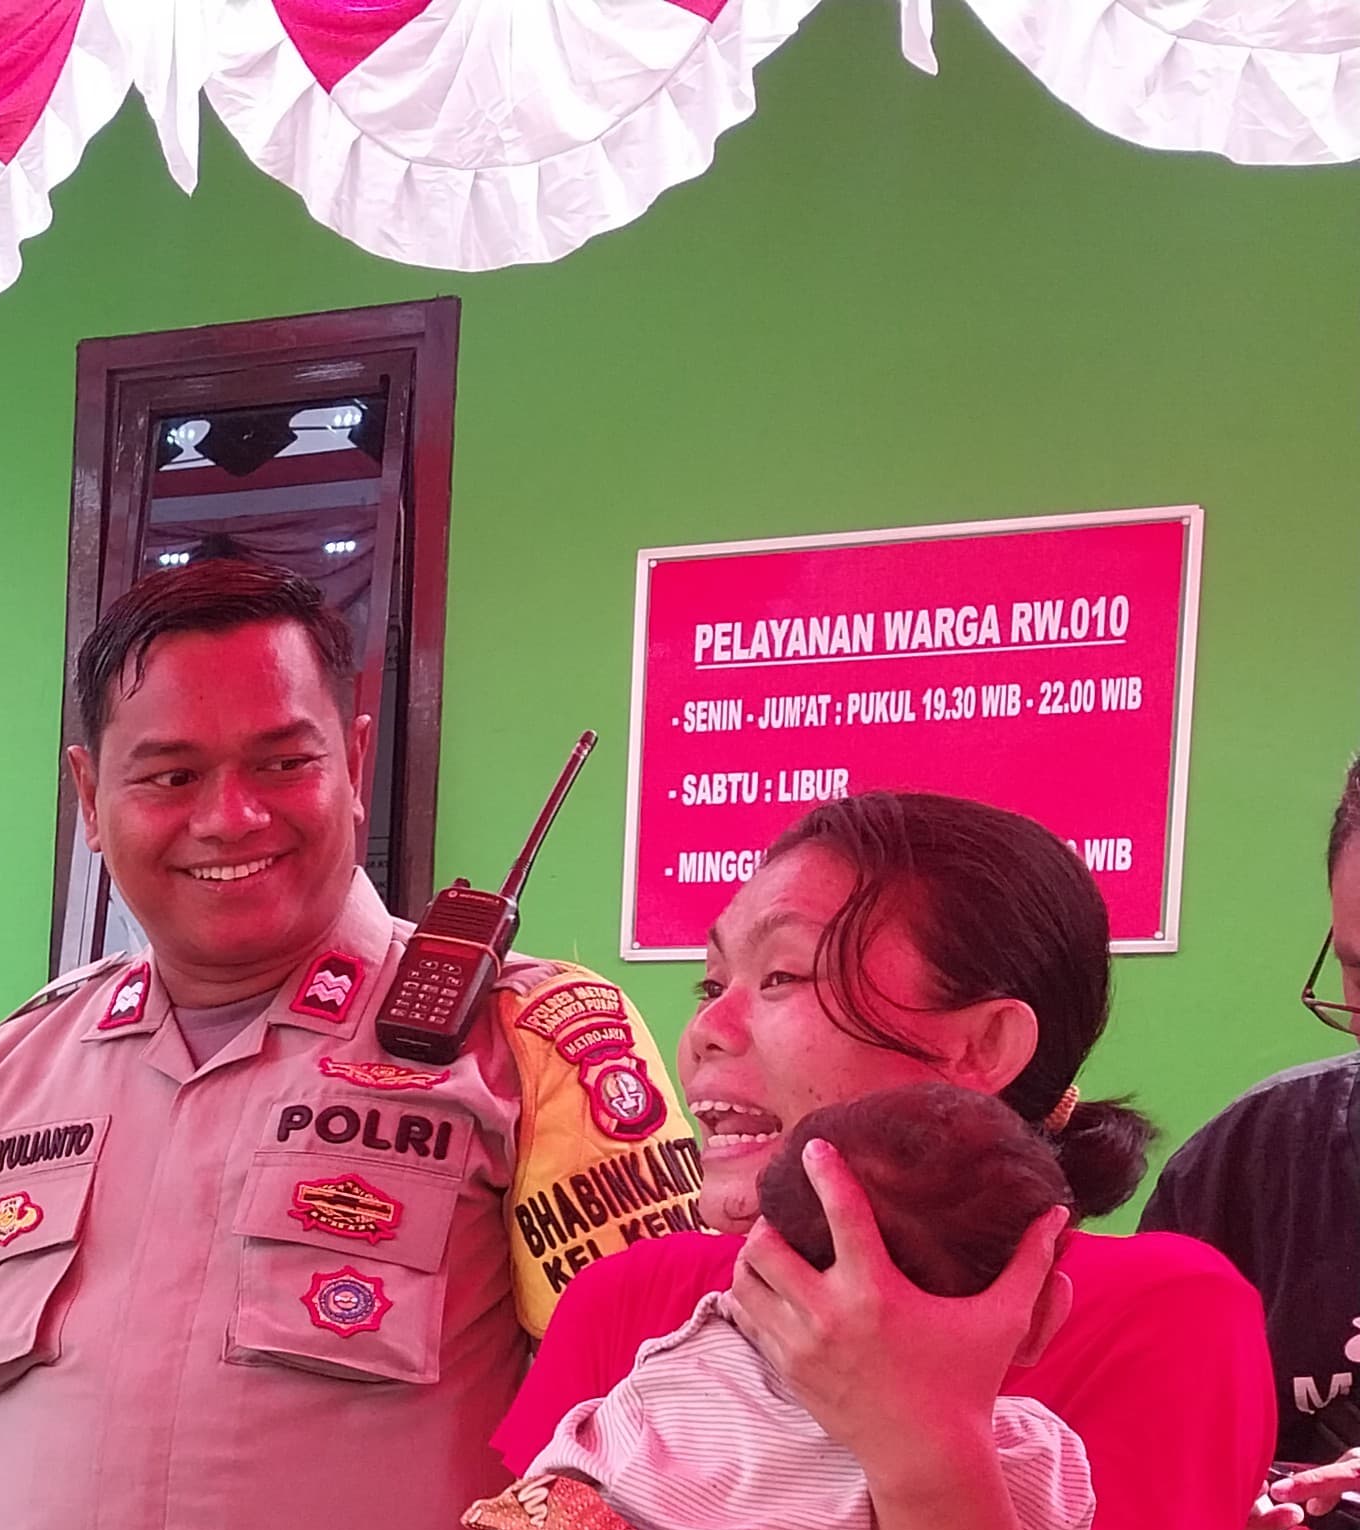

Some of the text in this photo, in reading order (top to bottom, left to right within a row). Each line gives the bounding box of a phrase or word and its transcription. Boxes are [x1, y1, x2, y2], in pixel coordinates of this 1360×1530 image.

[694, 595, 1129, 664] PELAYANAN WARGA RW.010
[683, 699, 743, 733] SENIN
[847, 690, 916, 725] PUKUL
[922, 685, 976, 721] 19.30
[981, 683, 1021, 718] WIB
[1038, 679, 1096, 715] 22.00
[1101, 676, 1142, 711] WIB
[681, 771, 759, 806] SABTU
[778, 768, 849, 802] LIBUR
[1084, 838, 1132, 872] WIB
[573, 986, 619, 1002] METRO
[277, 1104, 454, 1161] POLRI
